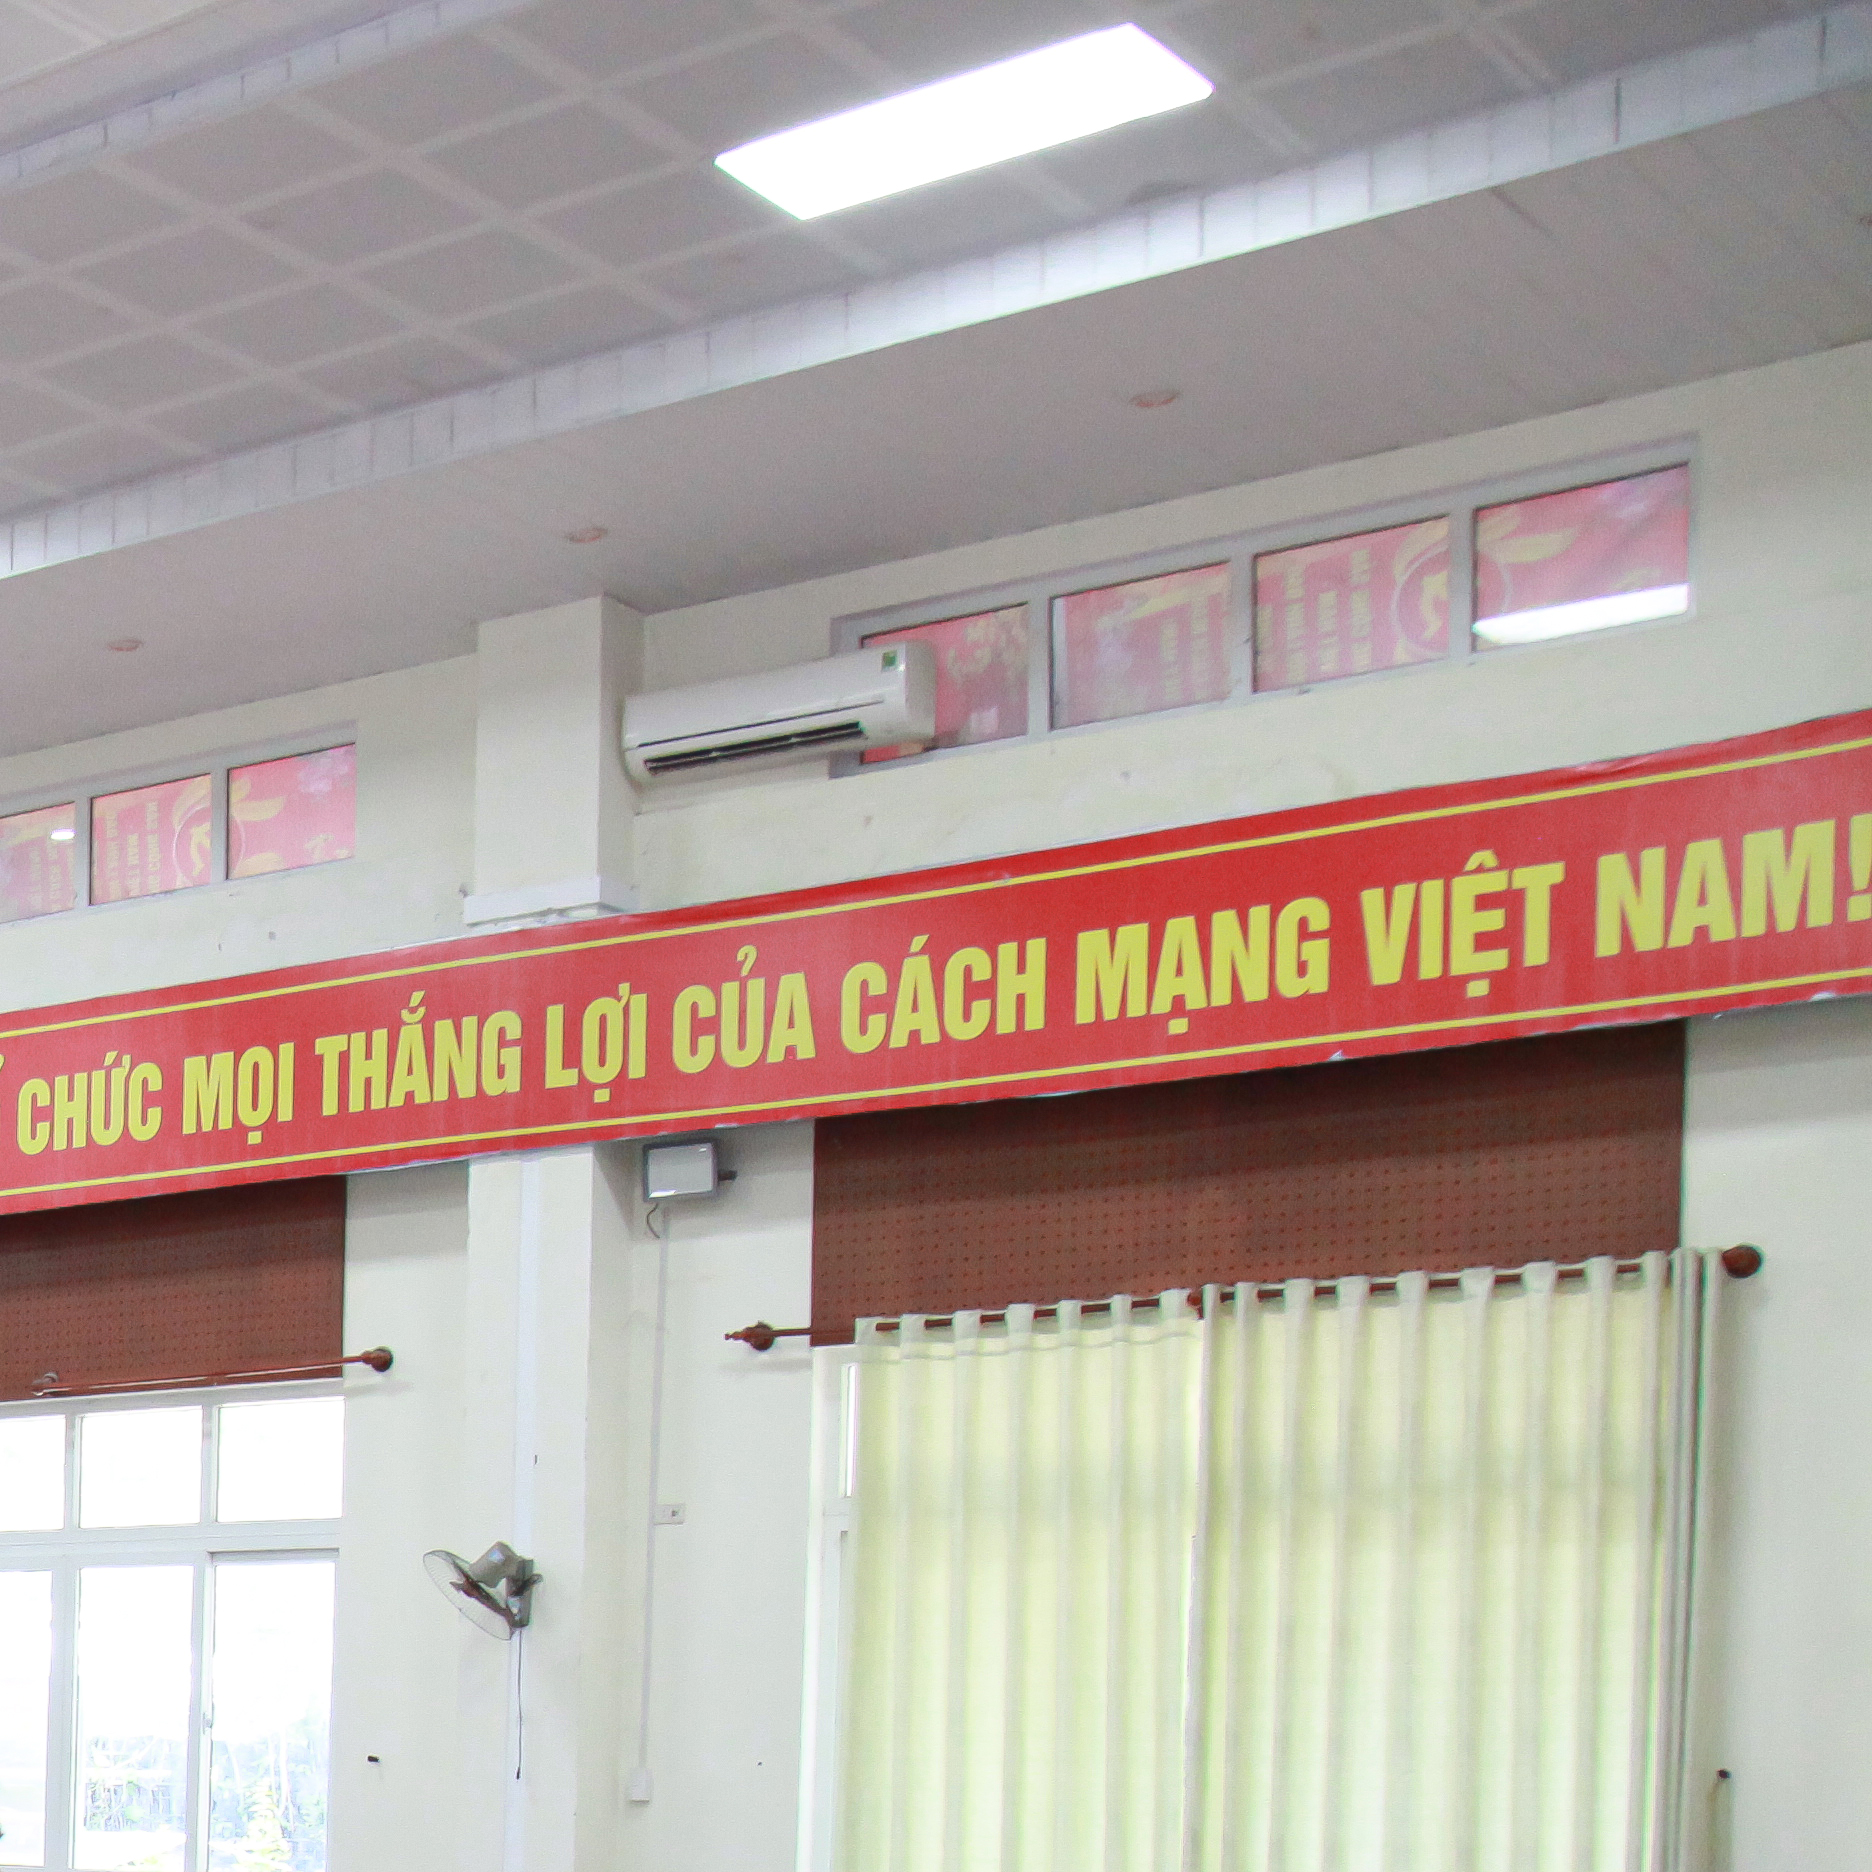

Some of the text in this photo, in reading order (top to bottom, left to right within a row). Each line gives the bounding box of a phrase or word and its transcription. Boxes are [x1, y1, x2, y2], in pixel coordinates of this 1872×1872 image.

[16, 1051, 163, 1155] CHỨC
[182, 1041, 295, 1144] MỌI
[314, 990, 522, 1116] THẮNG
[545, 982, 648, 1104] LỢI
[671, 944, 816, 1075] CỦA
[841, 935, 1047, 1054] CÁCH
[1074, 896, 1331, 1035] MẠNG
[1361, 850, 1565, 998] VIỆT
[1594, 813, 1872, 958] NAM!
